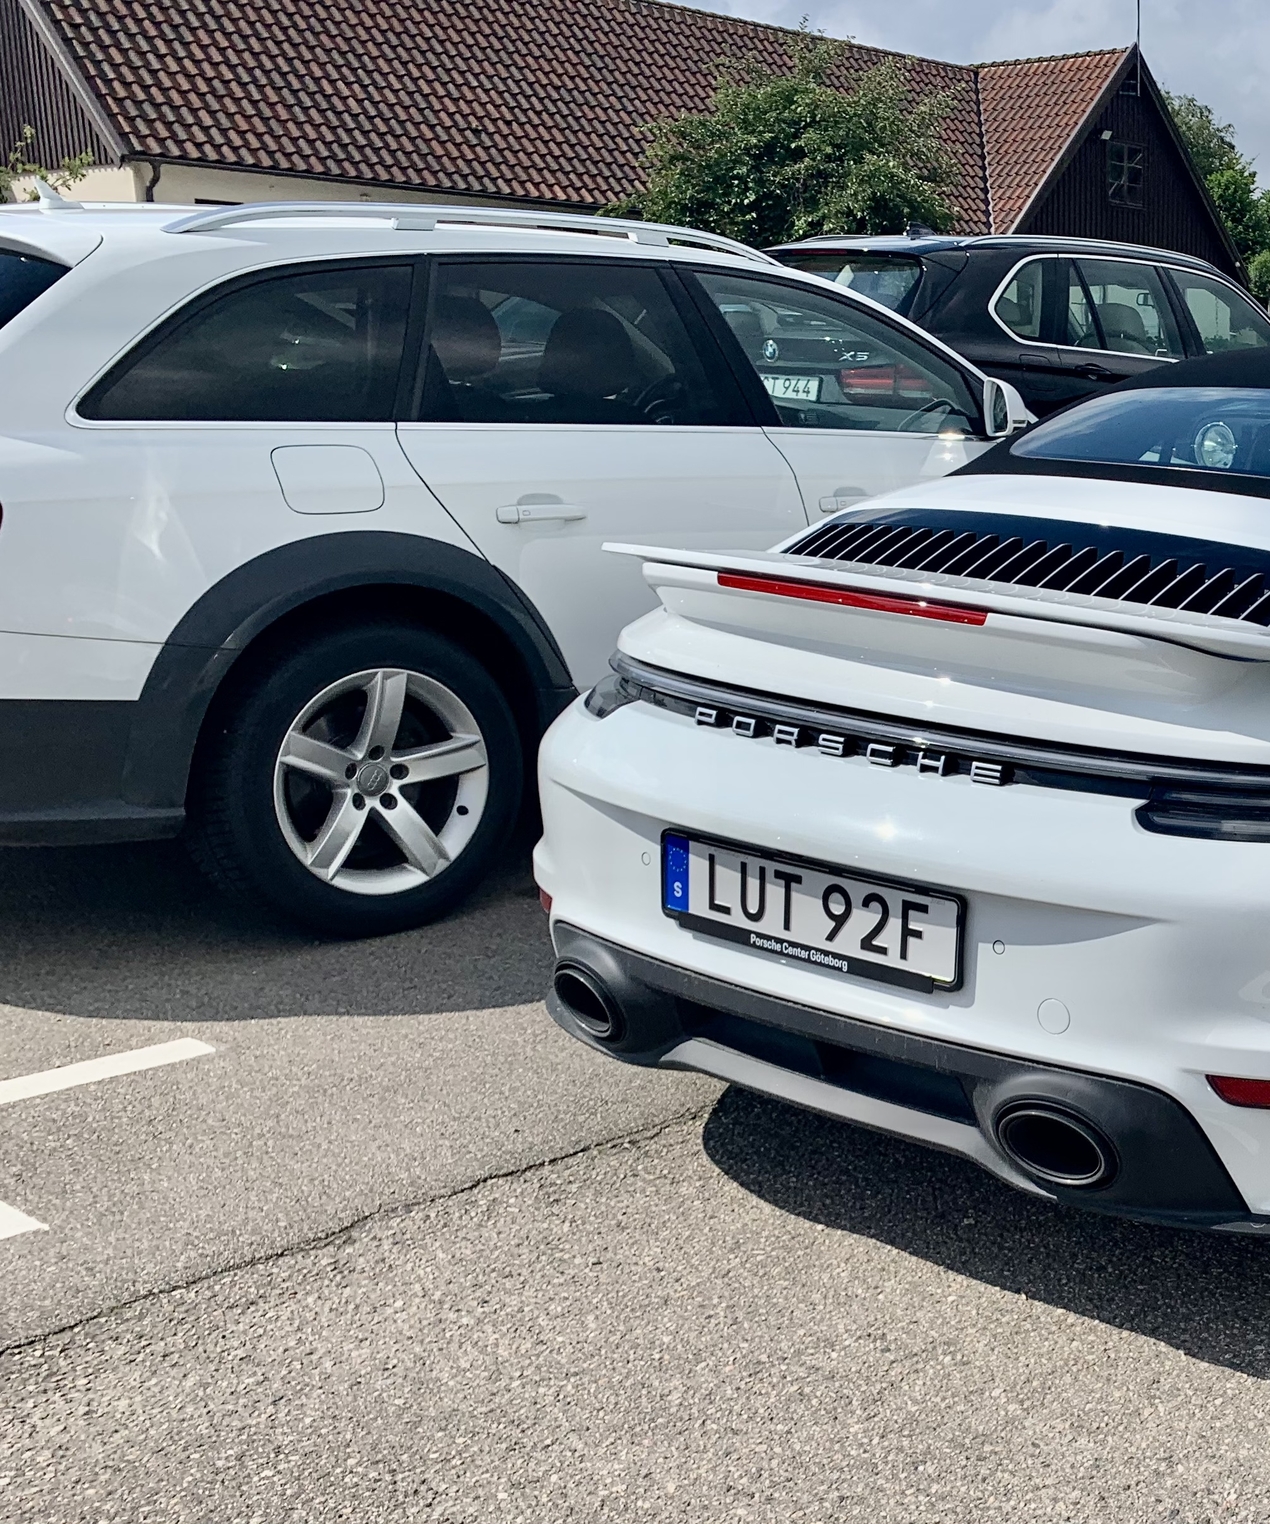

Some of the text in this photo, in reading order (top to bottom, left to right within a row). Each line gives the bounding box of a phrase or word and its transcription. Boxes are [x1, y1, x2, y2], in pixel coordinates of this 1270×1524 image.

[838, 351, 869, 362] X5
[782, 377, 811, 397] 944
[694, 706, 1003, 786] PORSCHE
[673, 881, 683, 898] S
[708, 853, 929, 962] LUT 92F
[750, 933, 848, 973] Porsche Center Göteborg
